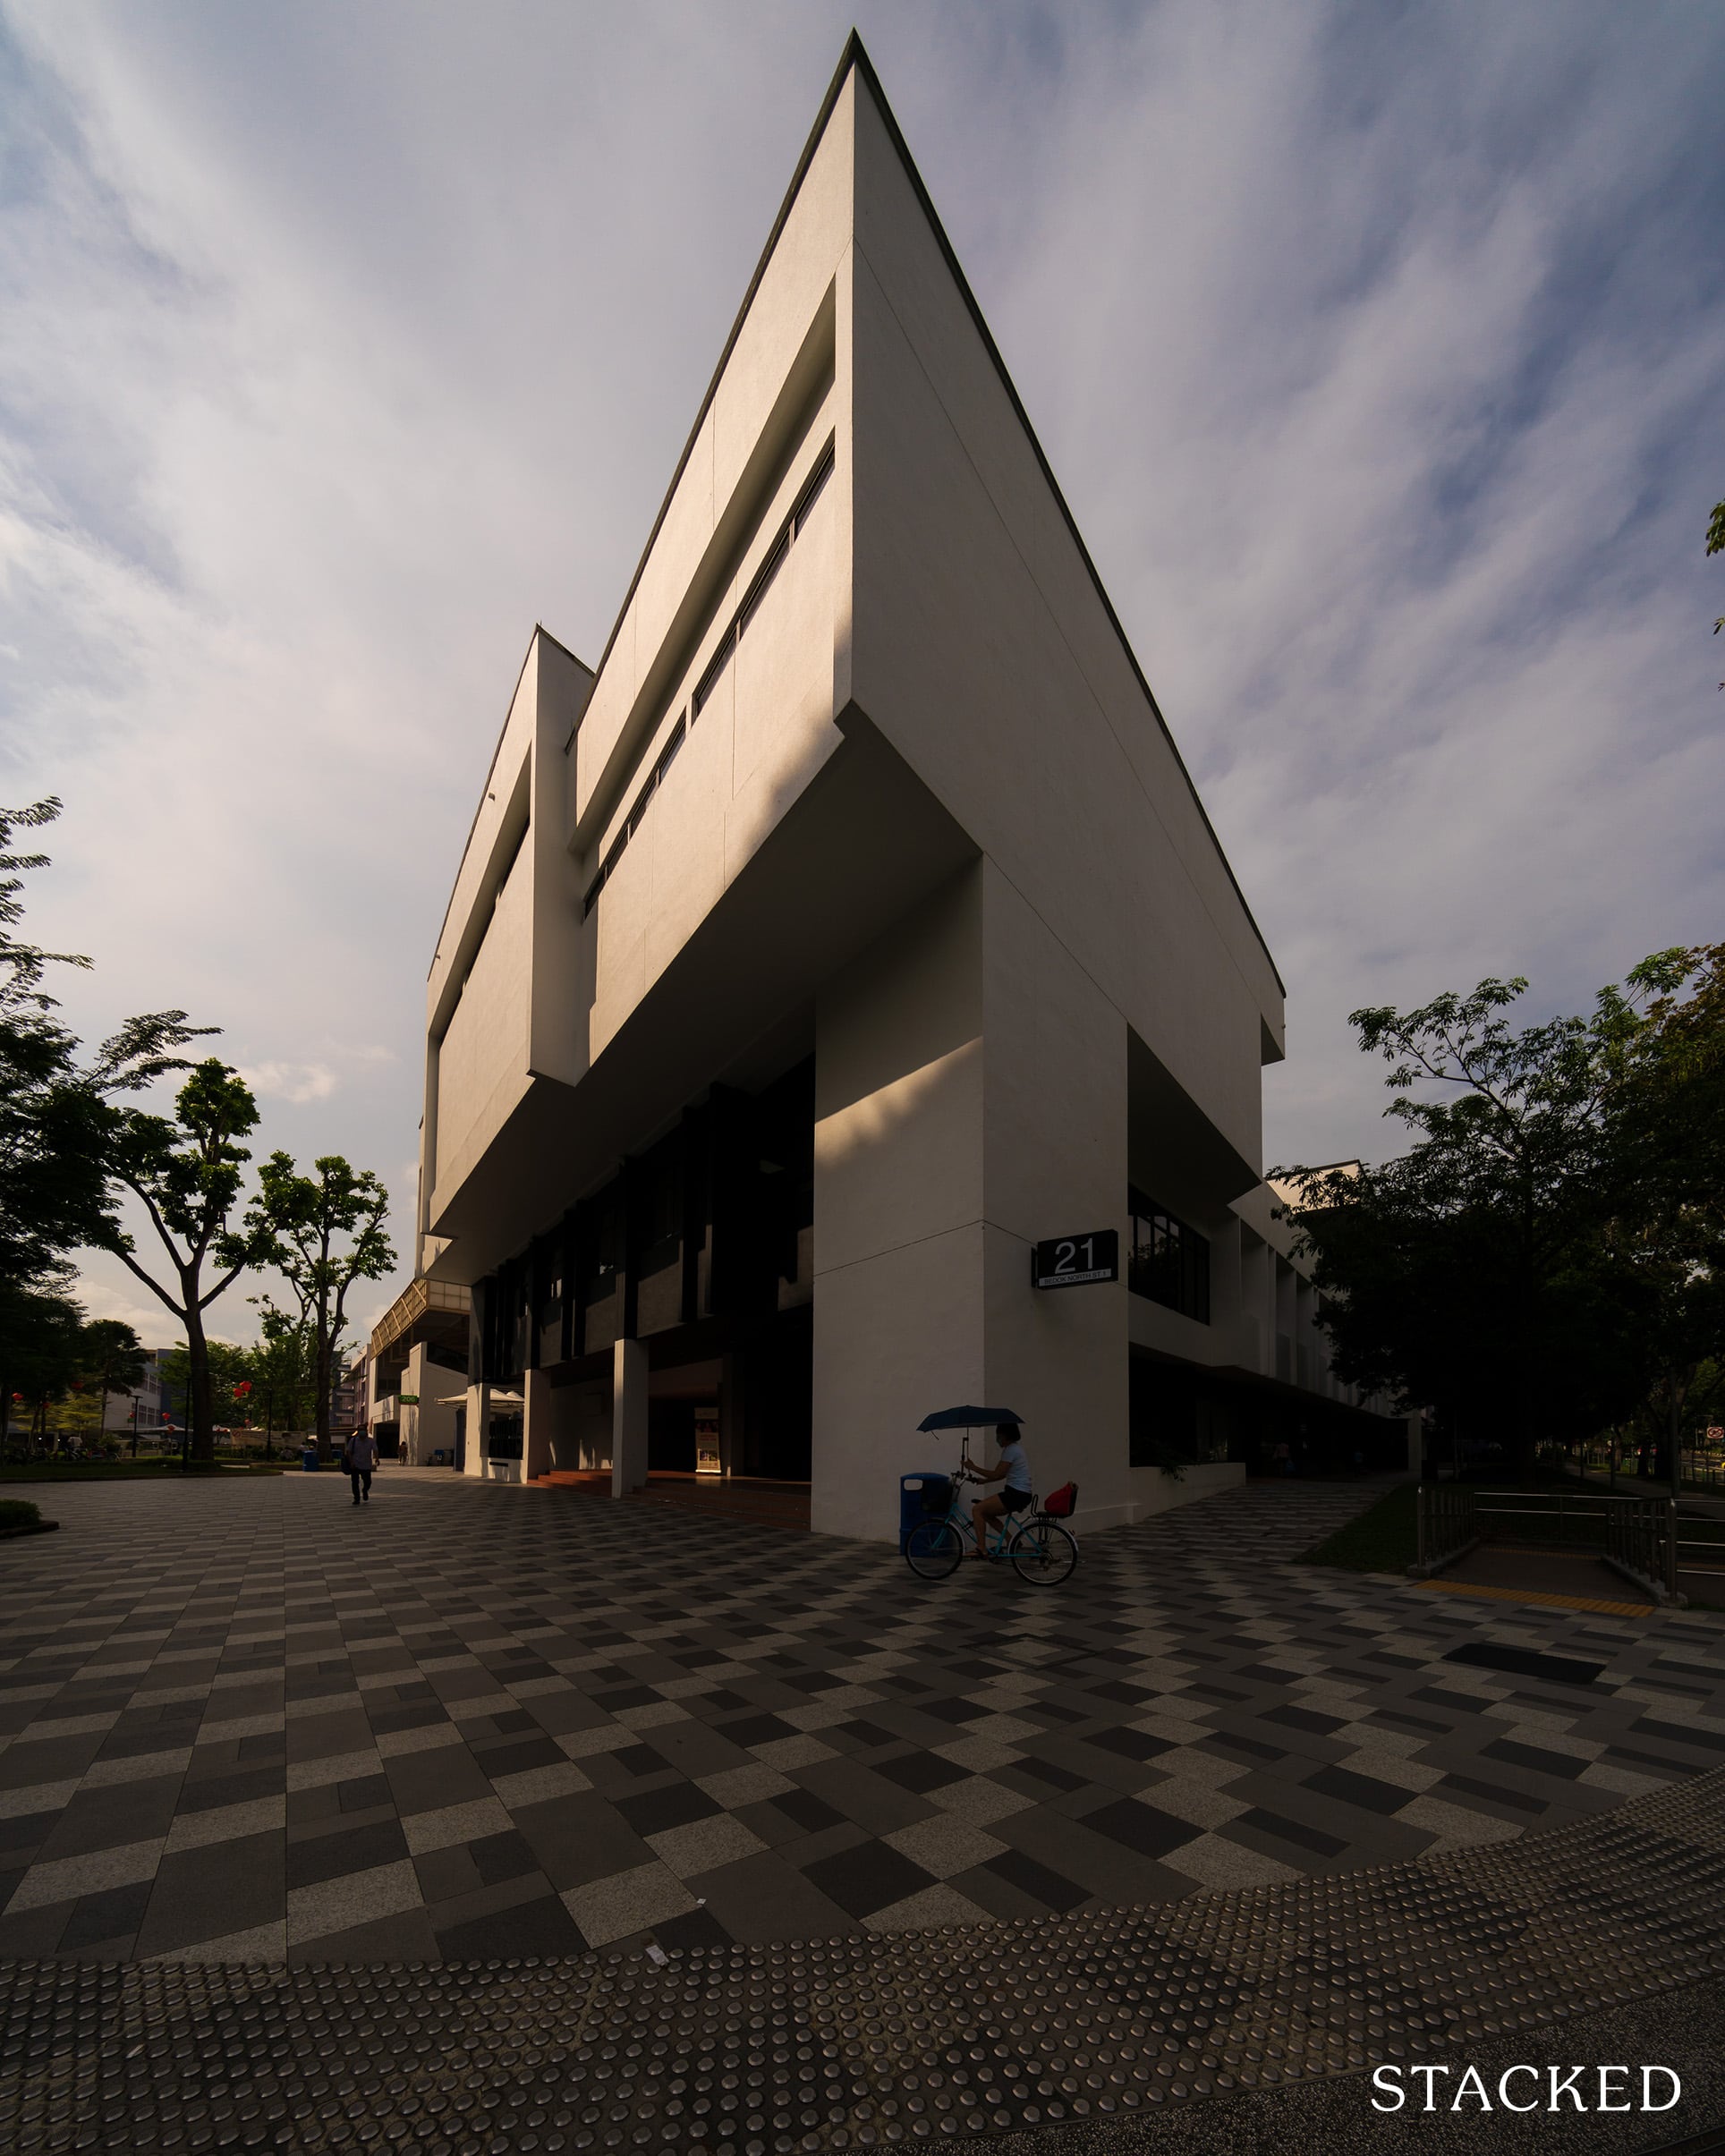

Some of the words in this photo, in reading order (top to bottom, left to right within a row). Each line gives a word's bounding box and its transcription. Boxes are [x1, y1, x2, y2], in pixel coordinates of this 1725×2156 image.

[1055, 1237, 1093, 1274] 21
[1044, 1277, 1066, 1285] BEDOK
[1067, 1273, 1091, 1282] NORTH
